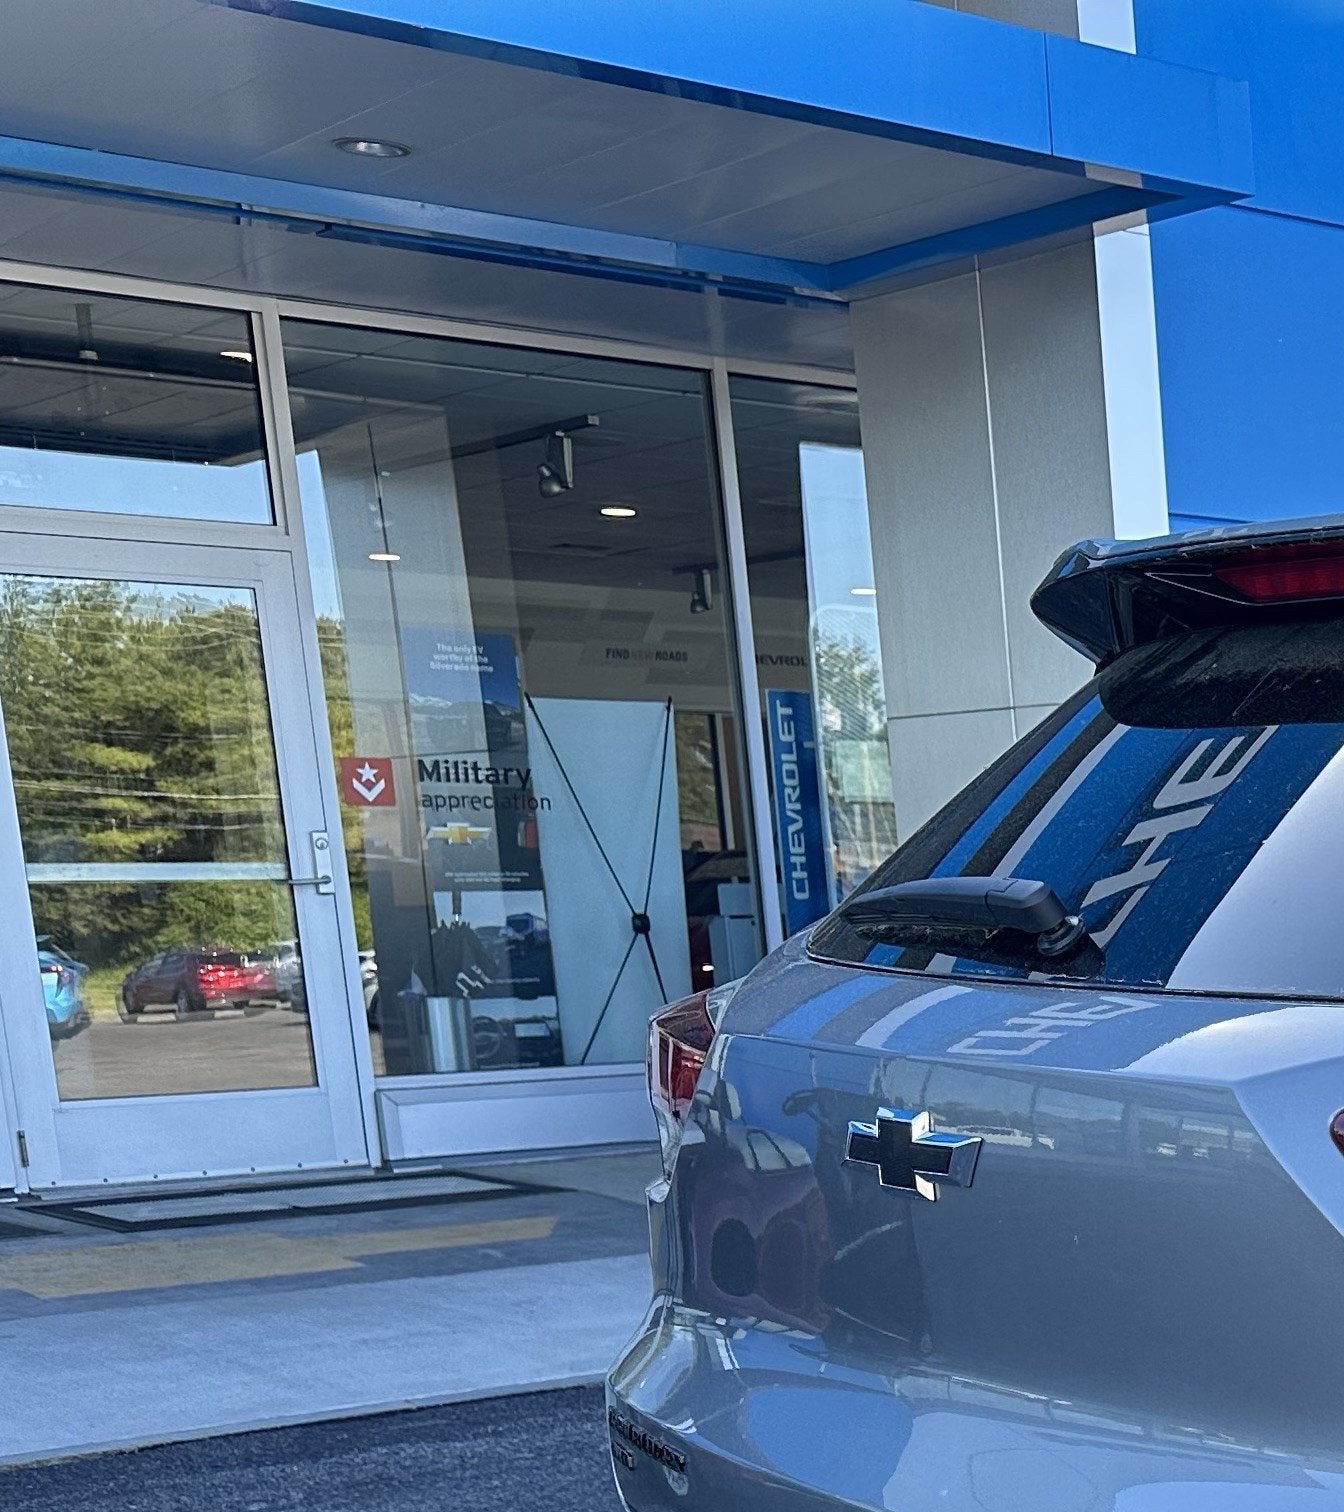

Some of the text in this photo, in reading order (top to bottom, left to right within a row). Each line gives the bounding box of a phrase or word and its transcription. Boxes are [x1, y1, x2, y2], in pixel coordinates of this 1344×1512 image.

[606, 648, 630, 660] FIND
[654, 650, 688, 662] ROADS
[418, 759, 532, 791] Military
[421, 793, 552, 812] appreciation
[776, 699, 809, 901] CHEVROLET
